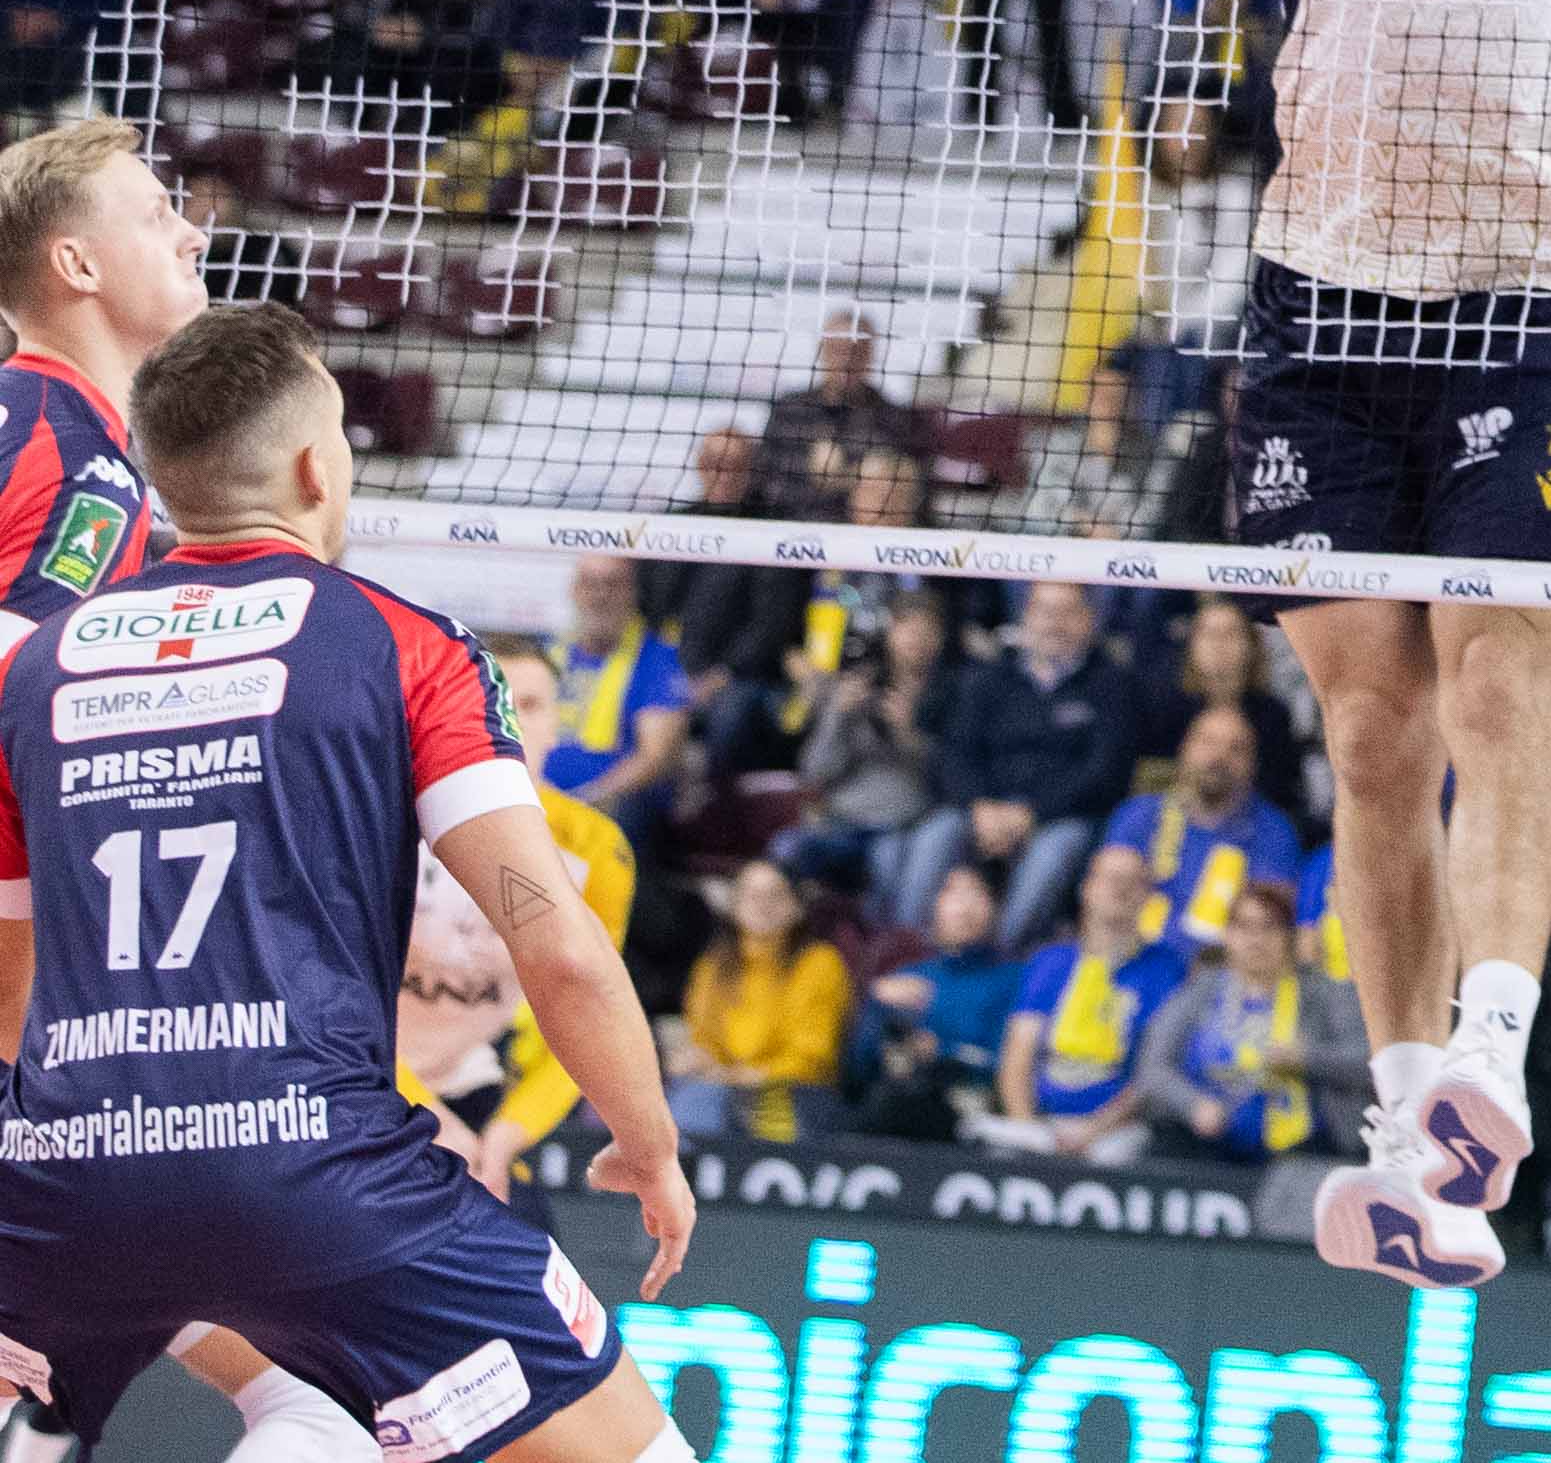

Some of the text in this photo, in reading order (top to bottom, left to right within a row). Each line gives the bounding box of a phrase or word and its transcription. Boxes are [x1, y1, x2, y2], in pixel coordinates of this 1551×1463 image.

[449, 521, 500, 545] RANA
[775, 540, 827, 564] RANA
[1105, 558, 1159, 581] RANA
[1441, 576, 1495, 599] RANA
[76, 599, 287, 643] GIOIELLA
[60, 734, 263, 793] PRISMA
[167, 770, 263, 794] FAMILIARI
[129, 794, 194, 810] TARANTO
[91, 819, 239, 973] 17
[44, 999, 288, 1072] ZIMMERMANN
[454, 1355, 512, 1398] Tarantini
